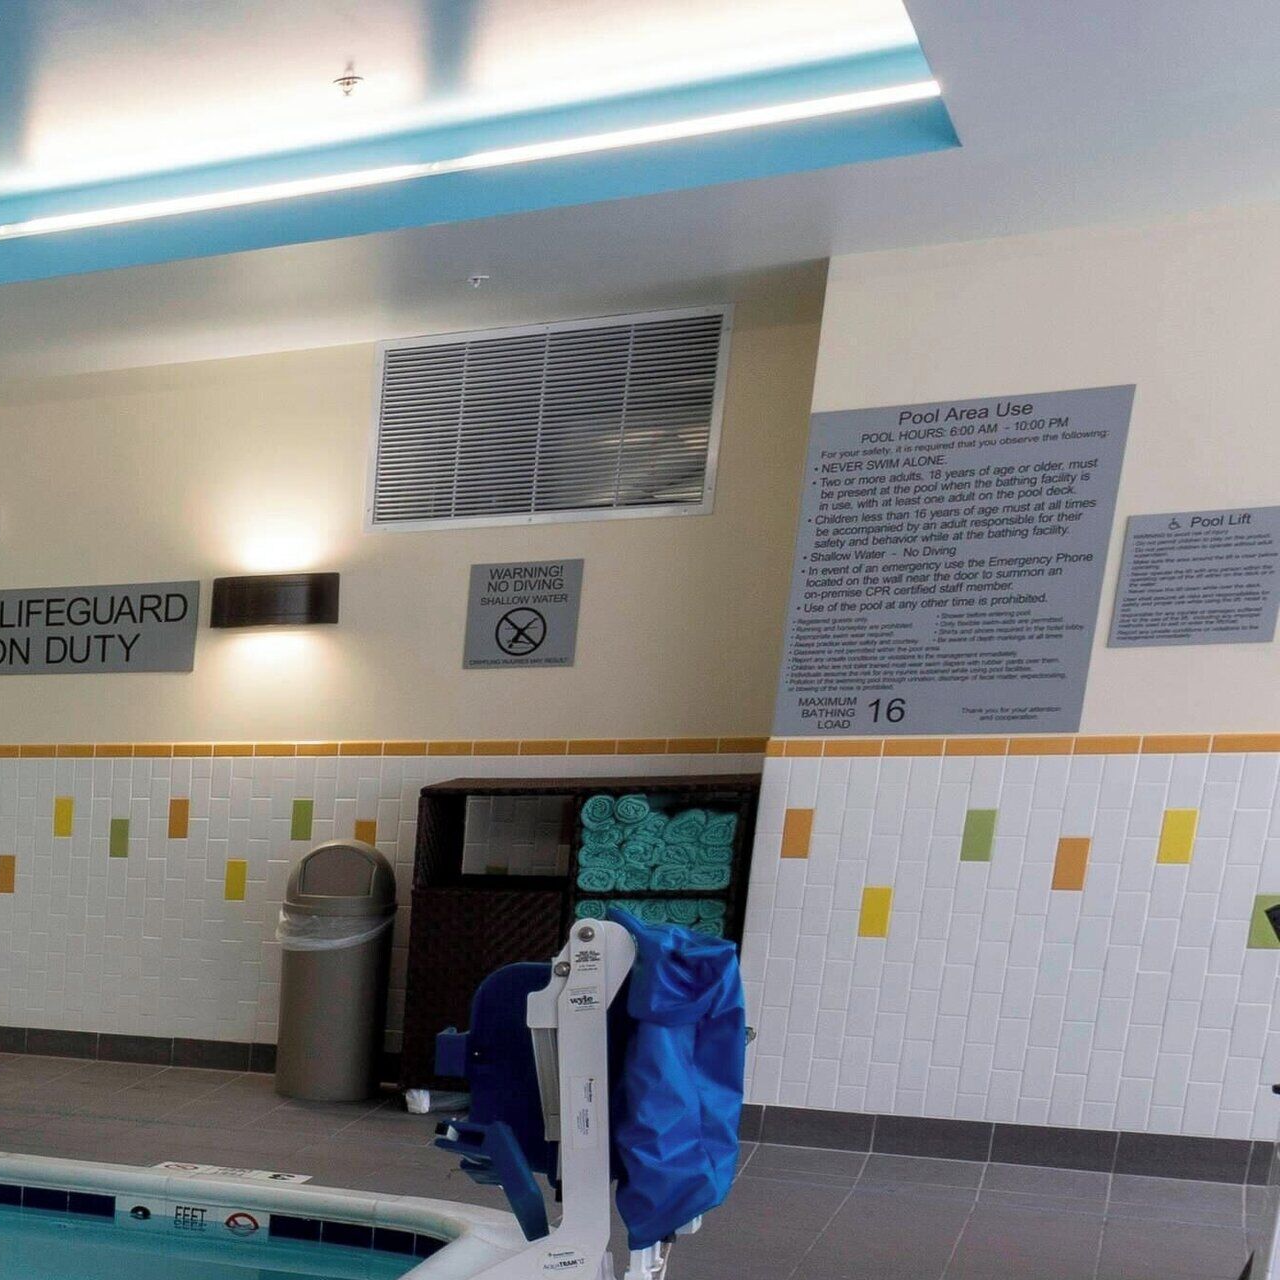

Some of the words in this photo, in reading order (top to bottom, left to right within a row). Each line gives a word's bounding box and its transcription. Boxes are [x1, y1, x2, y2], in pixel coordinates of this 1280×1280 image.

[898, 408, 939, 425] Pool
[944, 406, 988, 421] Area
[996, 401, 1033, 417] Use
[860, 431, 894, 443] POOL
[949, 424, 974, 436] 6:00
[977, 422, 998, 433] AM
[1014, 418, 1045, 430] 10:00
[1047, 416, 1068, 428] PM
[819, 476, 841, 487] Two
[843, 477, 856, 485] or
[857, 475, 886, 484] more
[928, 468, 941, 479] 18
[944, 468, 975, 479] years
[978, 465, 990, 476] of
[992, 465, 1015, 476] age
[1017, 464, 1030, 473] or
[1068, 458, 1098, 469] must
[821, 460, 863, 472] NEVER
[866, 458, 900, 470] SWIM
[820, 489, 834, 499] be
[836, 486, 877, 499] present
[879, 485, 890, 495] at
[893, 484, 910, 494] the
[913, 481, 938, 494] pool
[940, 480, 970, 490] when
[974, 478, 992, 488] the
[995, 475, 1037, 487] bathing
[1040, 472, 1077, 484] facility
[1080, 471, 1090, 481] is
[818, 501, 828, 510] in
[856, 497, 878, 508] with
[881, 497, 892, 507] at
[894, 495, 921, 506] least
[923, 494, 945, 504] one
[947, 491, 975, 502] adult
[977, 491, 993, 500] on
[996, 489, 1014, 499] the
[1017, 486, 1043, 499] pool
[814, 514, 858, 525] Children
[861, 512, 882, 522] less
[886, 511, 909, 520] than
[914, 508, 927, 518] 16
[929, 508, 960, 518] years
[963, 505, 975, 515] of
[976, 506, 999, 515] age
[1002, 502, 1030, 512] must
[1033, 501, 1045, 511] at
[1047, 499, 1061, 510] all
[1064, 499, 1096, 509] times
[1190, 515, 1224, 528] Pool
[1228, 513, 1252, 526] Lift
[815, 527, 829, 536] be
[831, 522, 903, 536] accompanied
[906, 522, 920, 532] by
[922, 521, 937, 530] an
[939, 518, 967, 529] adult
[969, 514, 1034, 528] responsible
[1038, 513, 1054, 522] for
[1056, 512, 1083, 521] their
[813, 537, 845, 548] safety
[848, 535, 868, 546] and
[871, 534, 918, 545] behavior
[920, 531, 949, 542] while
[952, 531, 963, 540] at
[966, 529, 984, 539] the
[987, 527, 1029, 538] bathing
[809, 551, 851, 562] Shallow
[854, 549, 886, 559] Water
[903, 547, 919, 557] No
[922, 545, 956, 556] Diving
[490, 565, 563, 580] WARNING!
[808, 566, 818, 575] In
[820, 564, 849, 575] event
[851, 563, 863, 573] of
[864, 565, 878, 573] an
[881, 561, 941, 572] emergency
[944, 560, 964, 569] use
[967, 558, 985, 568] the
[988, 555, 1052, 567] Emergency
[1055, 553, 1093, 562] Phone
[487, 580, 509, 593] NO
[514, 578, 564, 592] DIVING
[805, 576, 843, 587] located
[845, 577, 859, 585] on
[862, 574, 879, 584] the
[881, 573, 903, 584] wall
[905, 573, 930, 582] near
[933, 571, 950, 581] the
[953, 570, 979, 580] door
[982, 570, 992, 579] to
[995, 568, 1044, 578] summon
[1047, 567, 1062, 576] an
[480, 596, 529, 606] SHALLOW
[532, 593, 568, 604] WATER
[803, 587, 862, 599] on-premise
[865, 585, 890, 596] CPR
[893, 583, 936, 595] certified
[939, 582, 963, 593] staff
[0, 594, 188, 628] LIFEGUARD
[803, 602, 824, 613] Use
[827, 601, 838, 611] of
[840, 601, 856, 611] the
[858, 600, 883, 612] pool
[884, 600, 895, 609] at
[897, 600, 917, 609] any
[920, 597, 949, 608] other
[951, 596, 975, 606] time
[977, 597, 987, 605] is
[46, 633, 140, 664] DUTY
[798, 697, 857, 706] MAXIMUM
[868, 697, 905, 722] 16
[801, 708, 855, 717] BATHING
[817, 719, 850, 729] LOAD
